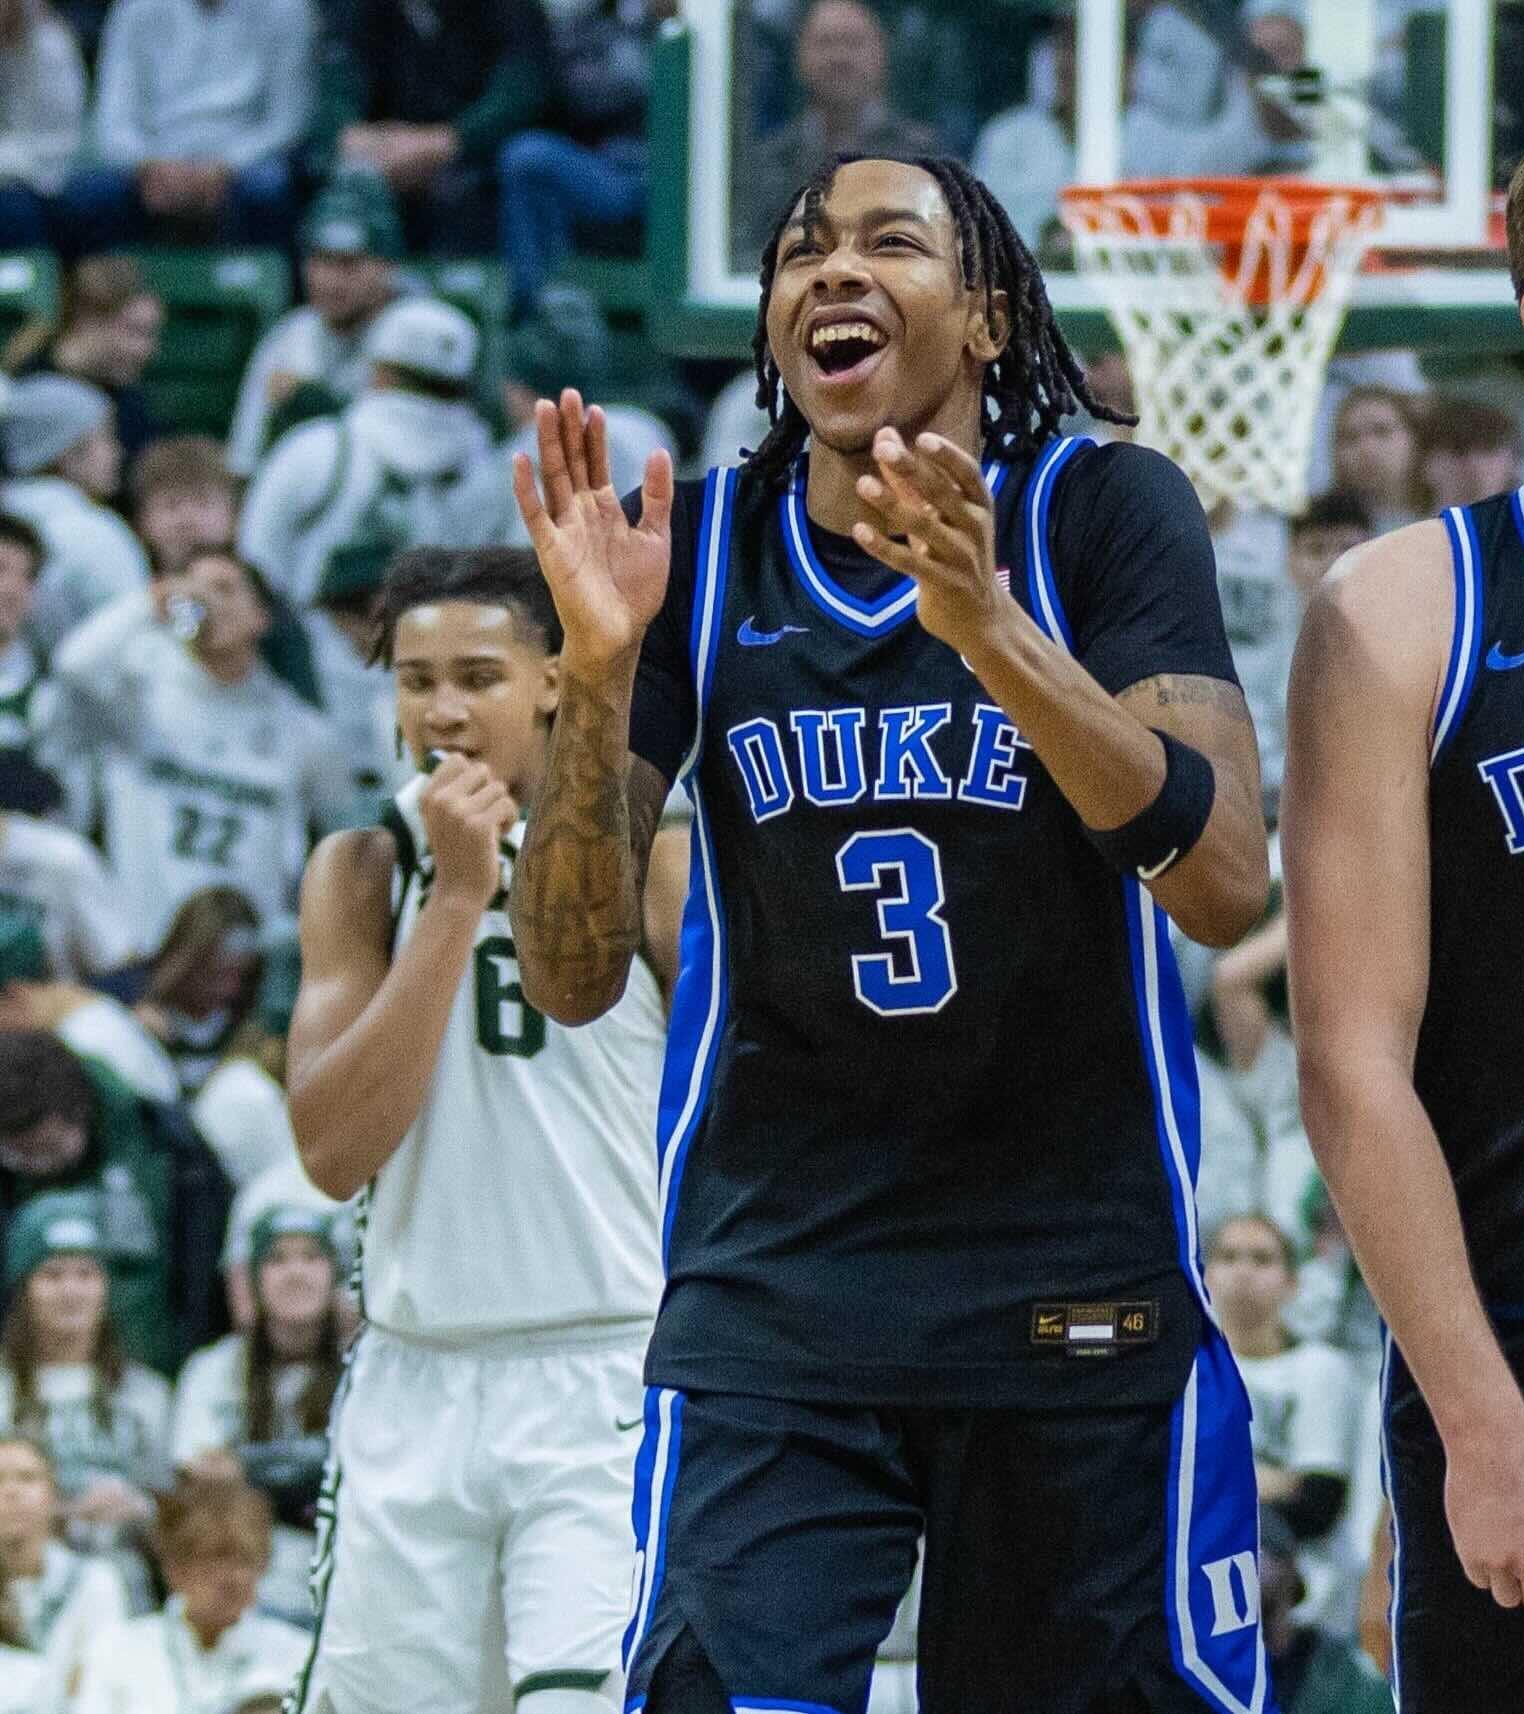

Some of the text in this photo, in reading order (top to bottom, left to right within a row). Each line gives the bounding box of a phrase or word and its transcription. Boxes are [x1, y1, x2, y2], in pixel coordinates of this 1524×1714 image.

[727, 703, 1032, 824] DUKE
[835, 827, 958, 1017] 3
[474, 936, 546, 1059] 6
[1122, 1312, 1145, 1331] 46
